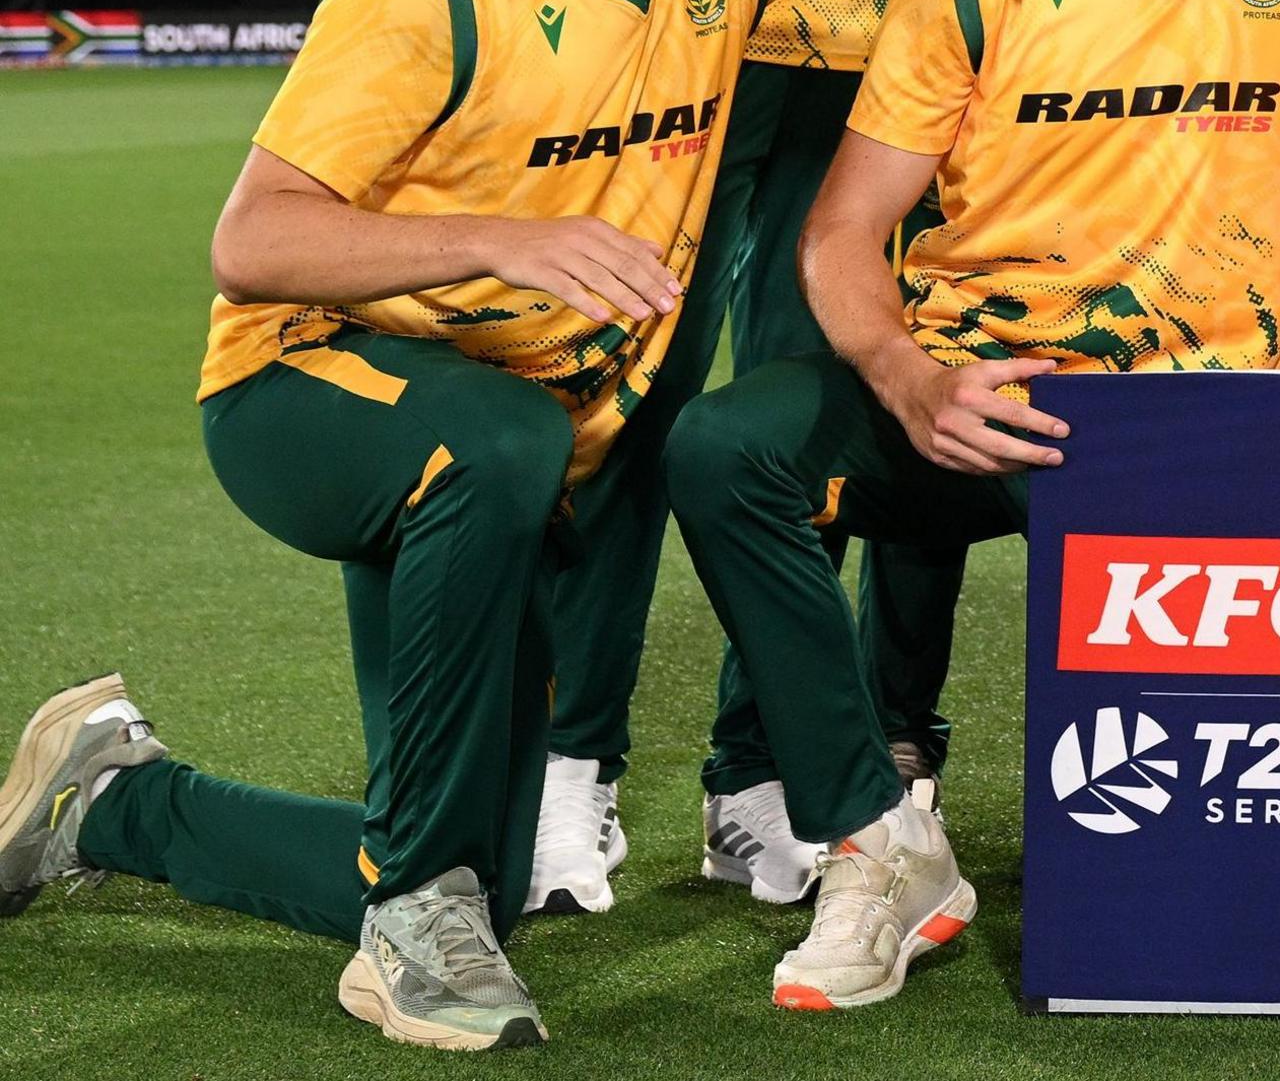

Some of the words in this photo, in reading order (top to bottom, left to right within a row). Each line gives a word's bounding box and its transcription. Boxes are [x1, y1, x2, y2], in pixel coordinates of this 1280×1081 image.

[1243, 11, 1280, 20] PROTEAS
[144, 23, 230, 52] SOUTH
[233, 22, 306, 51] AFRIC
[695, 22, 729, 38] PROTEAS
[1015, 81, 1280, 124] RADAR
[1175, 116, 1273, 133] TYRES
[650, 131, 712, 163] TYRE
